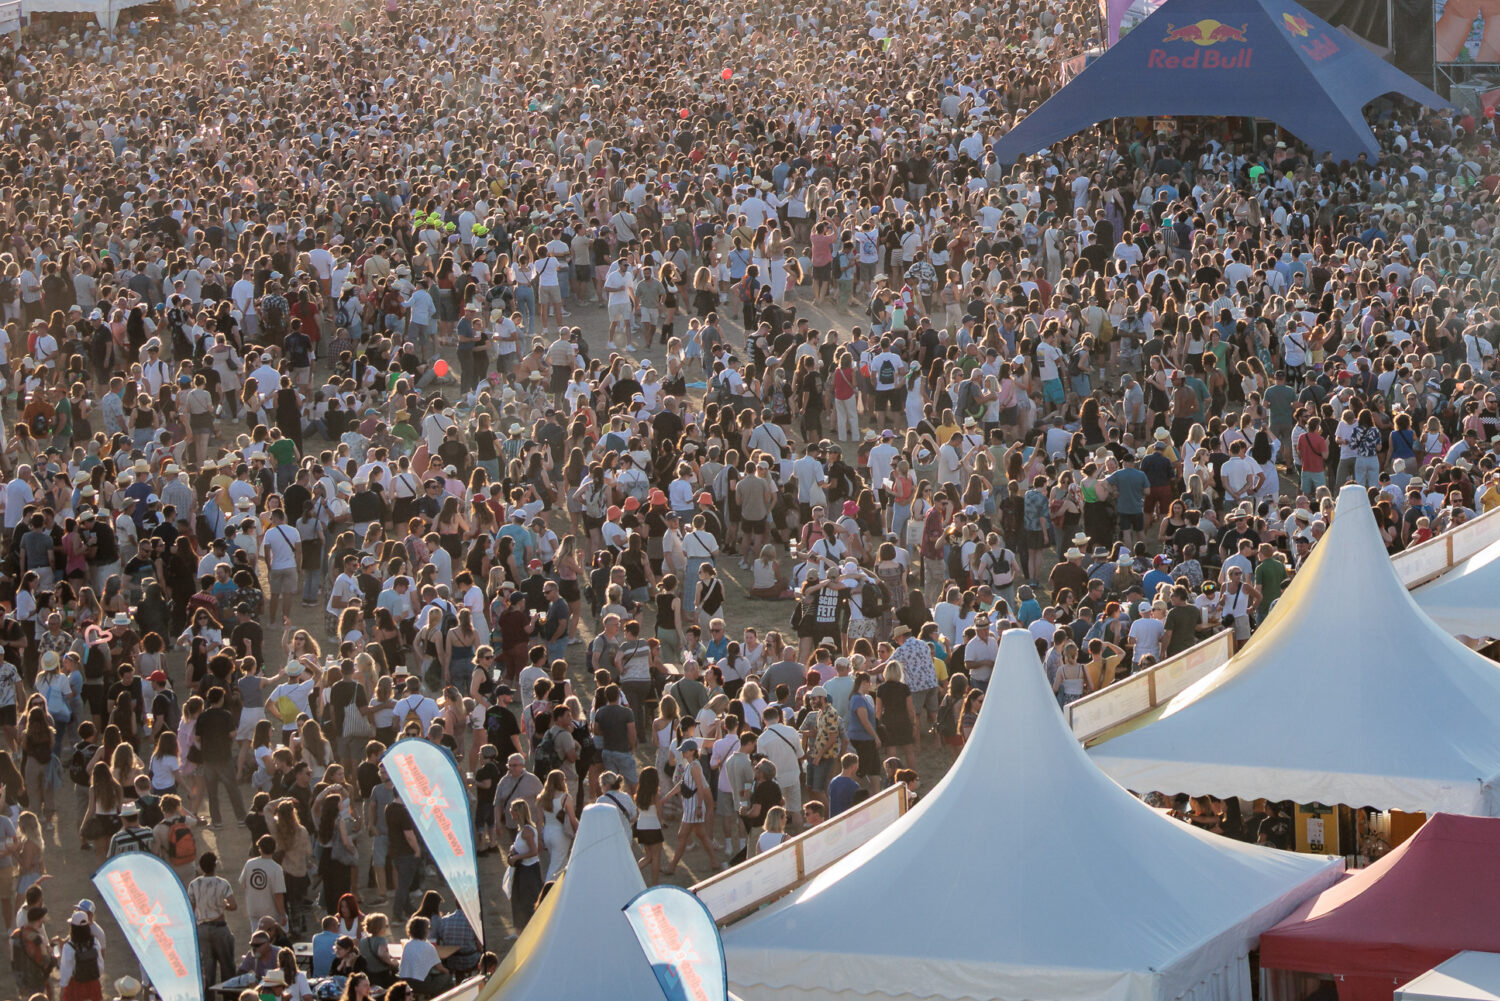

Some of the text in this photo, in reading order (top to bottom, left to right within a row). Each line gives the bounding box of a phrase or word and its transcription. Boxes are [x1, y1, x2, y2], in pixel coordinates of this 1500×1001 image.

[1148, 48, 1253, 69] Red Bull
[817, 605, 836, 617] FETT
